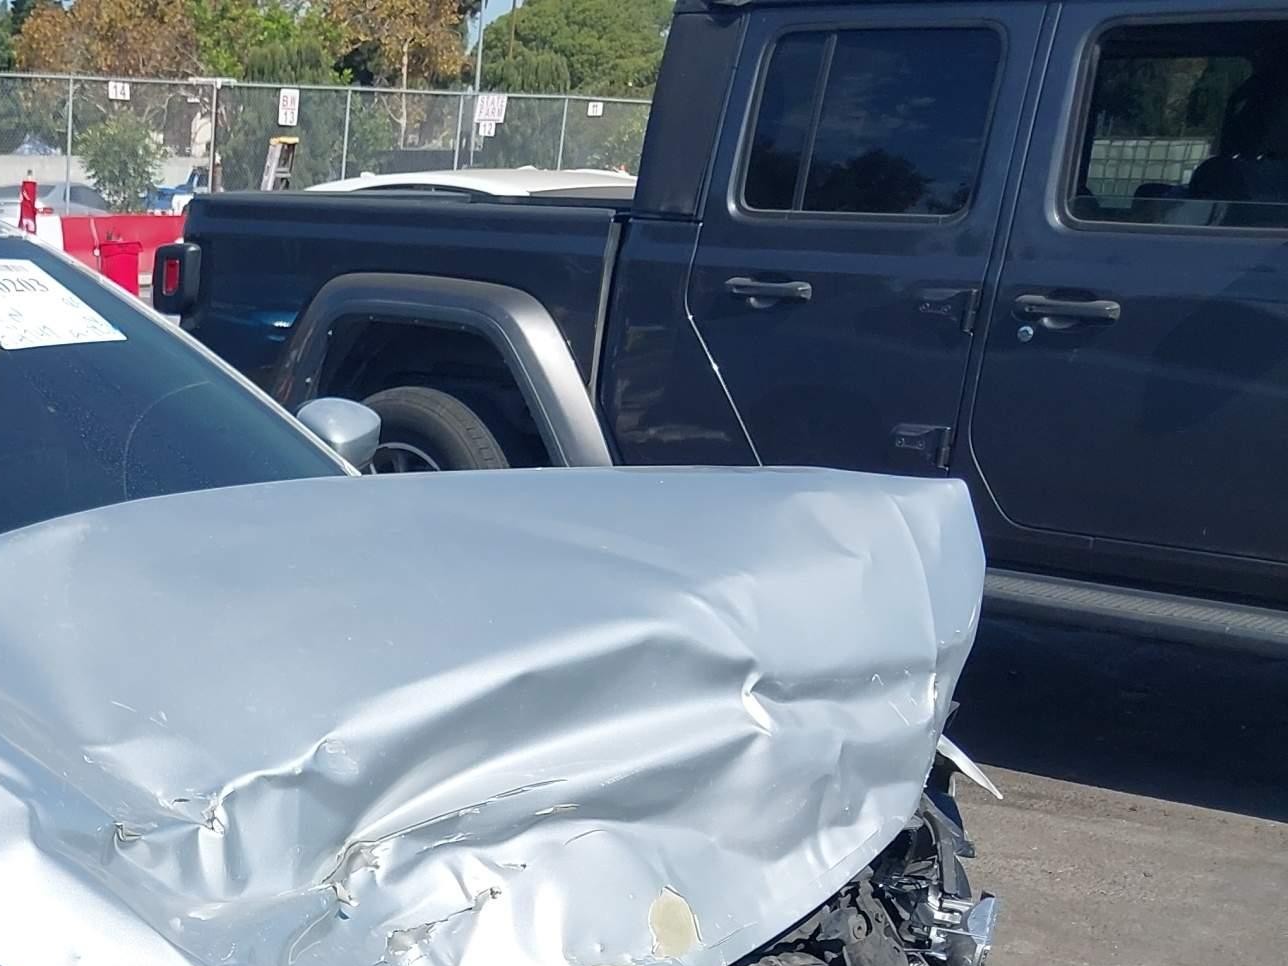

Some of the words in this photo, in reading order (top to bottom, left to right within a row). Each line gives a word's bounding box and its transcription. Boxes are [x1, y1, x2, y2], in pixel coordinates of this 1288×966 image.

[113, 84, 127, 99] 14
[592, 103, 598, 115] 11
[283, 111, 295, 124] 13
[483, 122, 493, 135] 12
